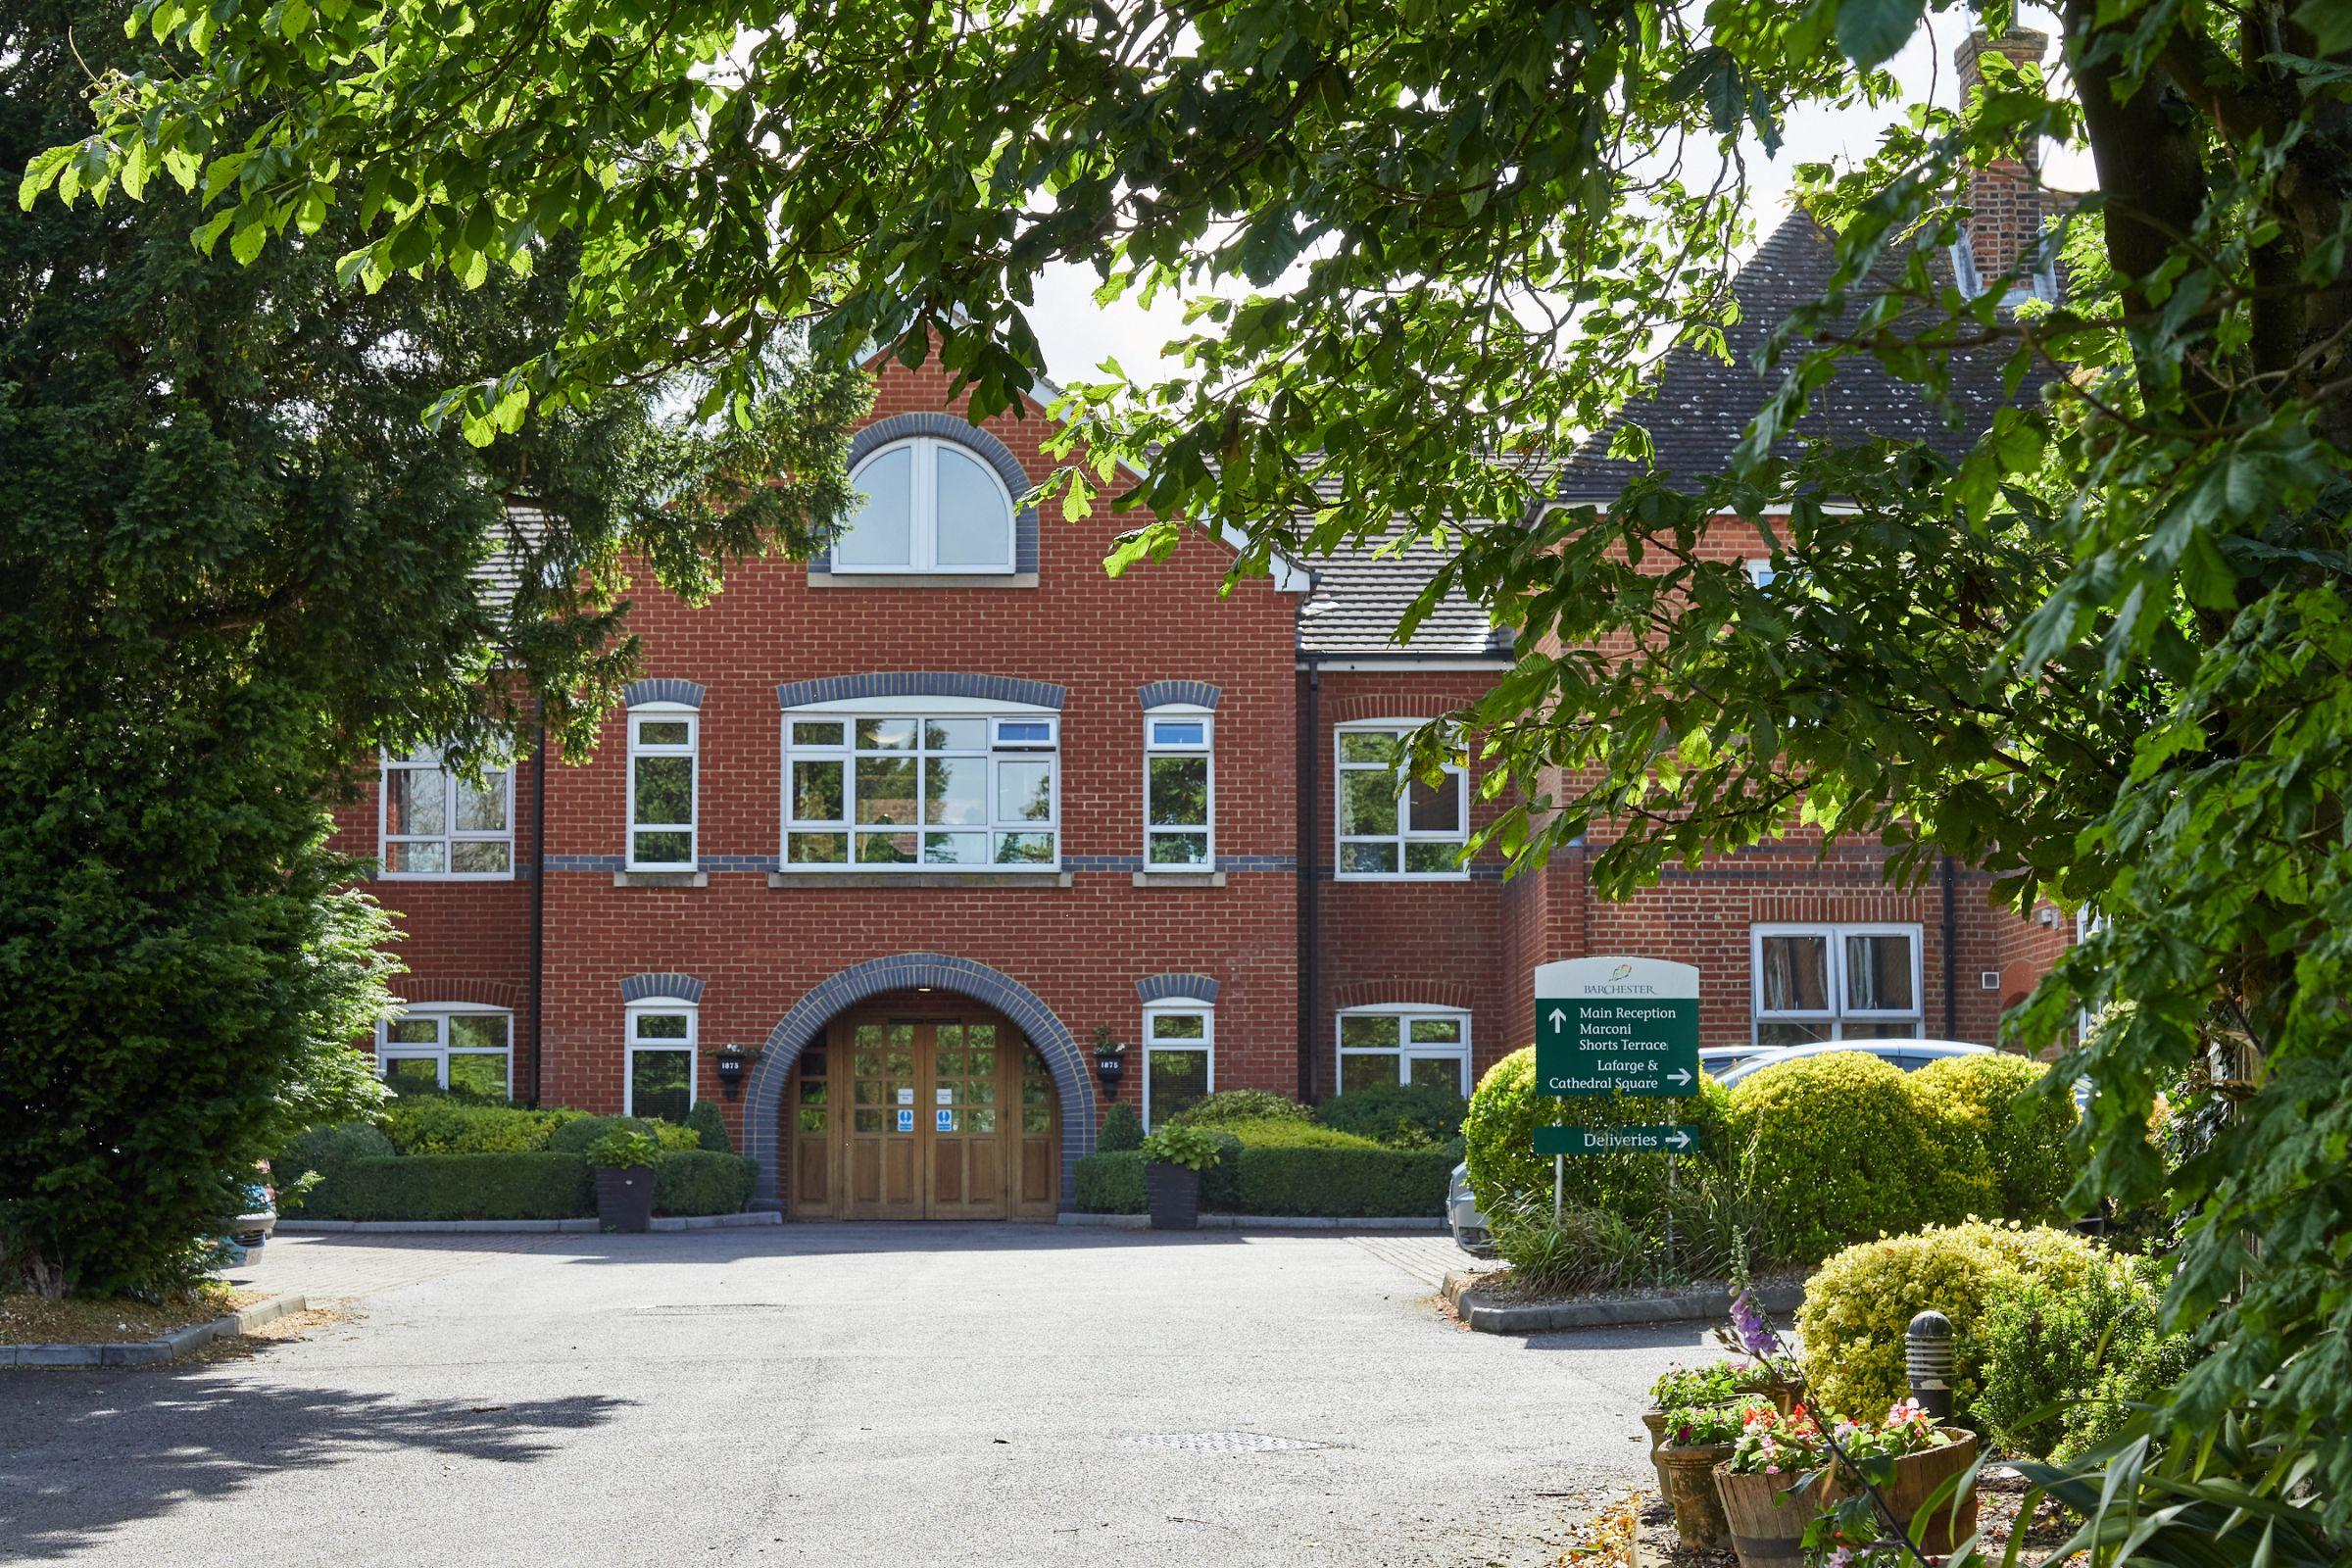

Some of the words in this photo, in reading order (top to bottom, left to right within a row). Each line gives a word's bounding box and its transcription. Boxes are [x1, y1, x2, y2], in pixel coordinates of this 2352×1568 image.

[1584, 985, 1658, 995] BARCHESTER
[1580, 1007, 1612, 1018] Main
[1616, 1007, 1676, 1021] Reception
[1580, 1024, 1631, 1035] Marconi
[1580, 1040, 1618, 1051] Shorts
[1621, 1040, 1667, 1051] Terrace
[1597, 1060, 1643, 1073] Lafarge
[1648, 1061, 1658, 1071] &
[1549, 1078, 1611, 1089] Cathedral
[1615, 1078, 1658, 1092] Square
[1584, 1134, 1657, 1147] Deliveries
